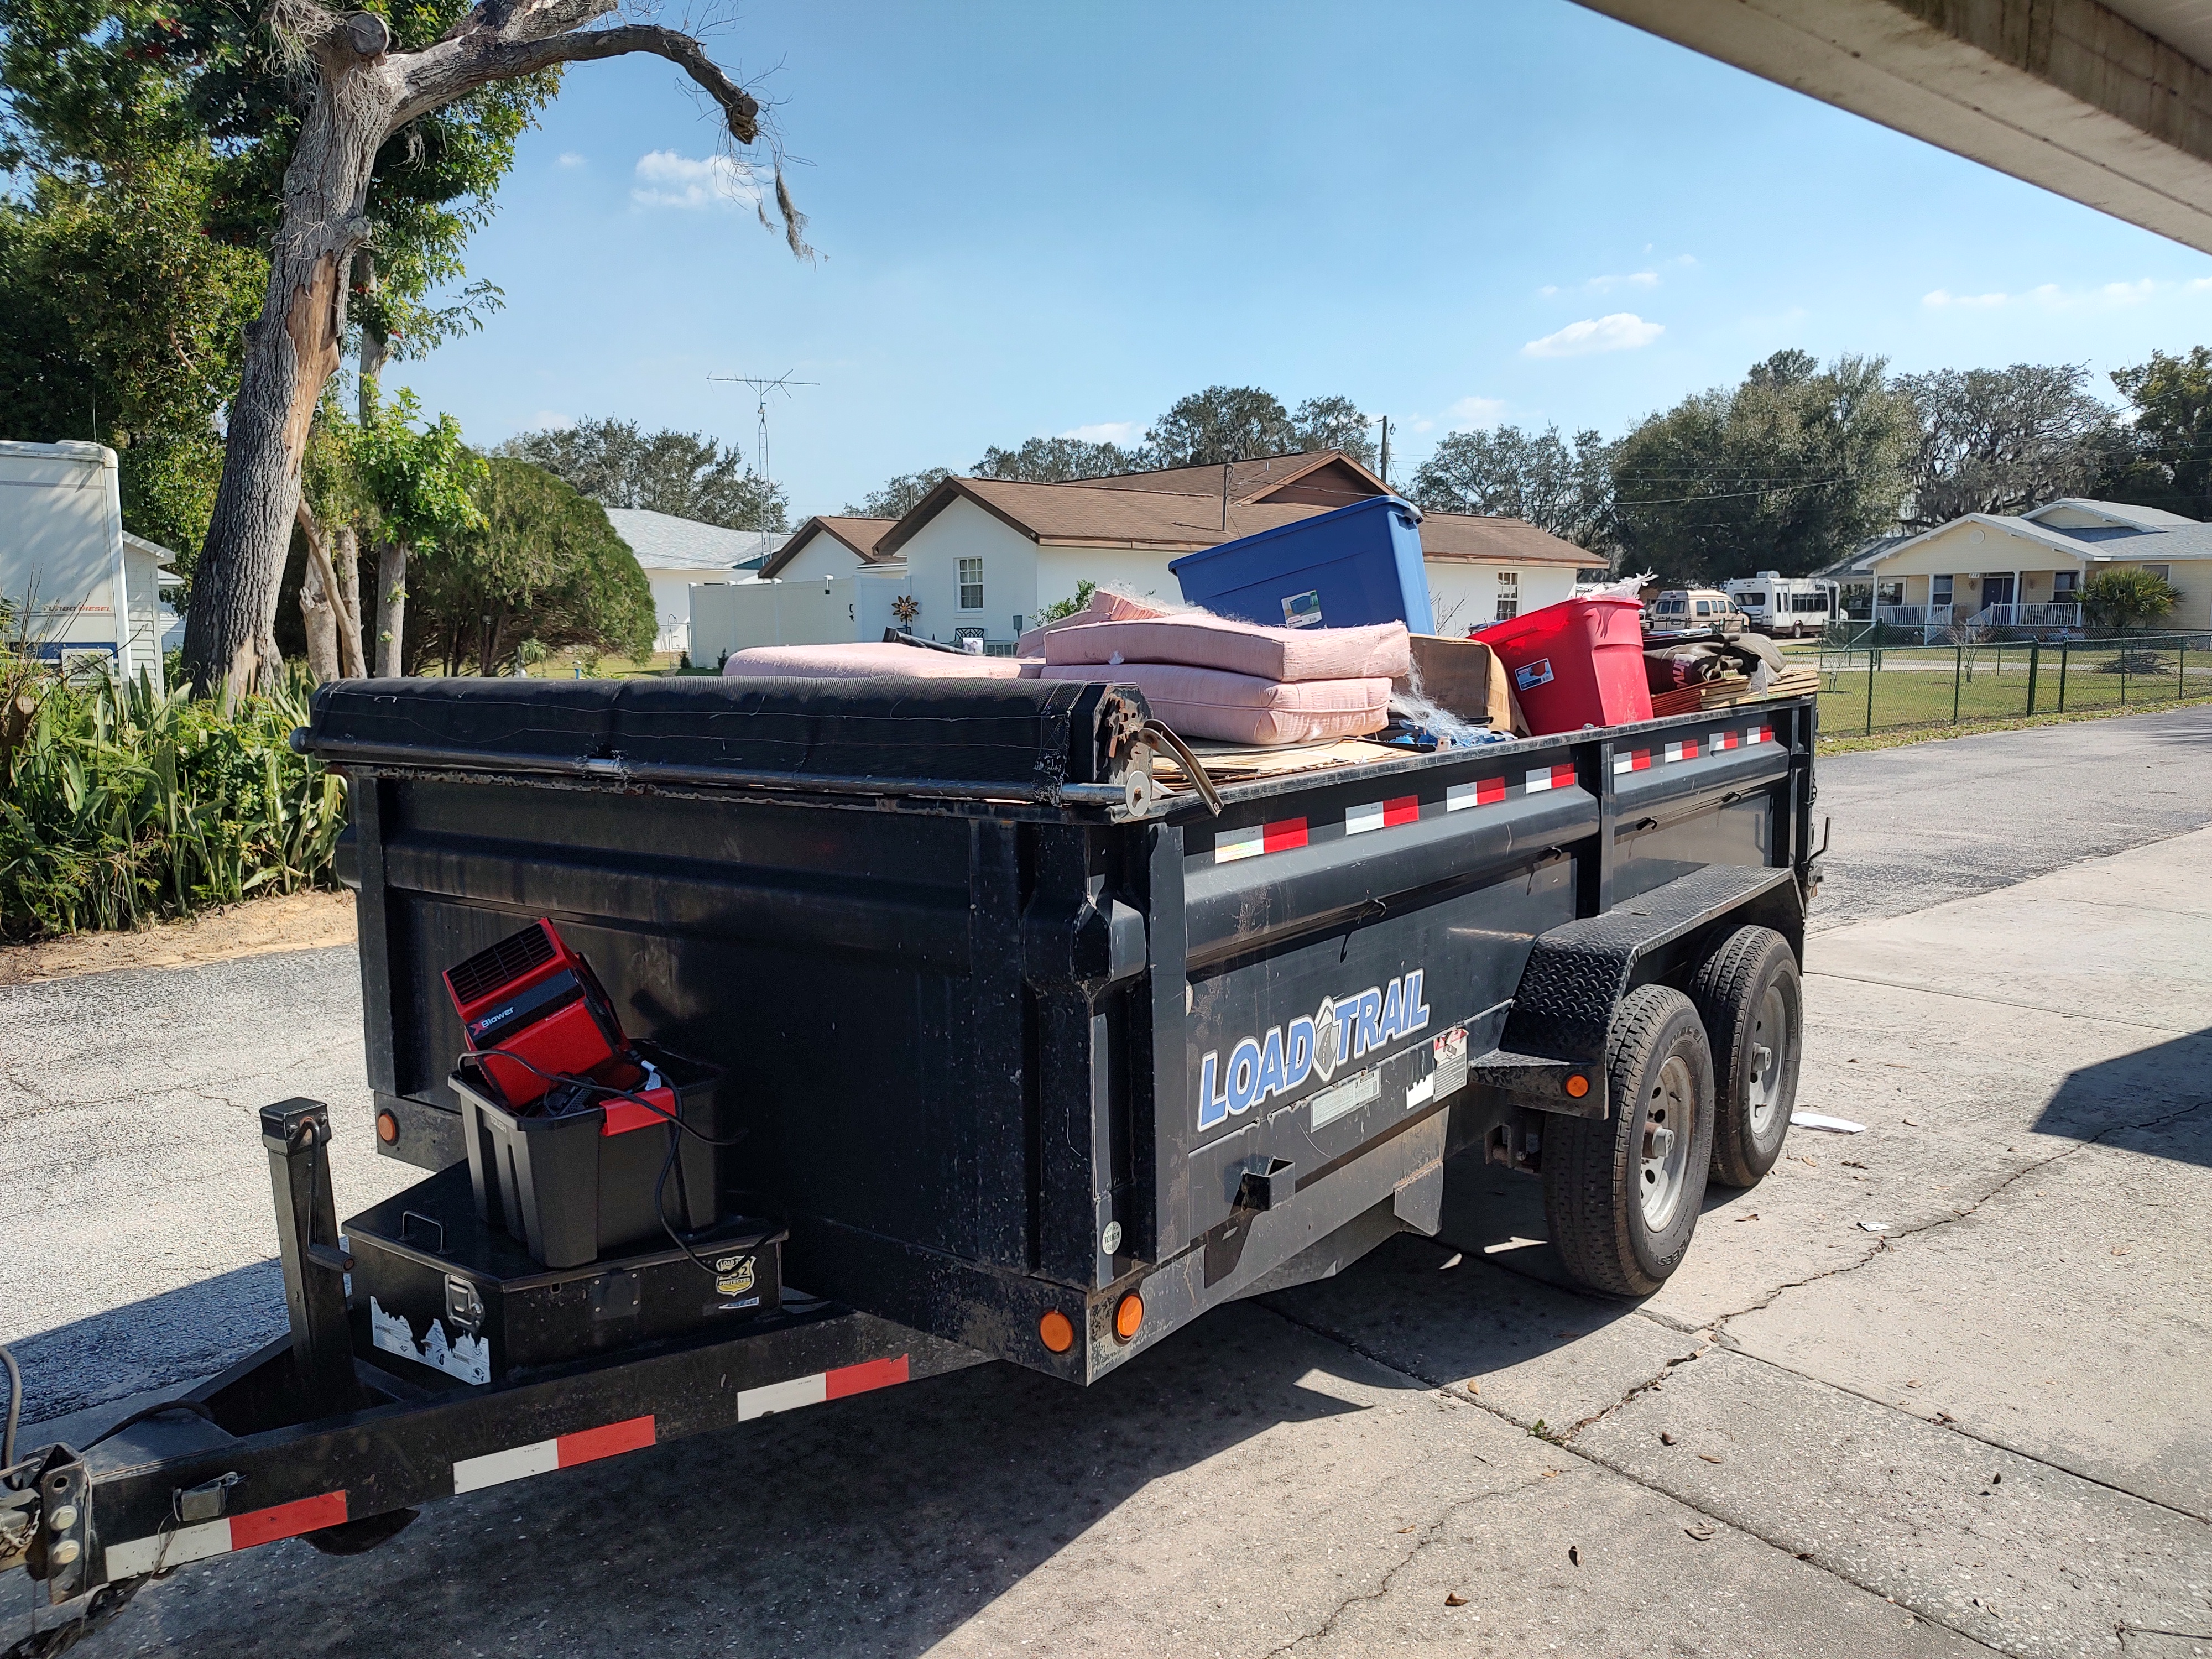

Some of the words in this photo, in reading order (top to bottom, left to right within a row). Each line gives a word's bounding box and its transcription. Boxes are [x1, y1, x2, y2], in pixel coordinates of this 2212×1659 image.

[1198, 1014, 1317, 1133] LOAD
[1333, 967, 1431, 1066] TRAIL
[1104, 1232, 1119, 1244] TOUGH
